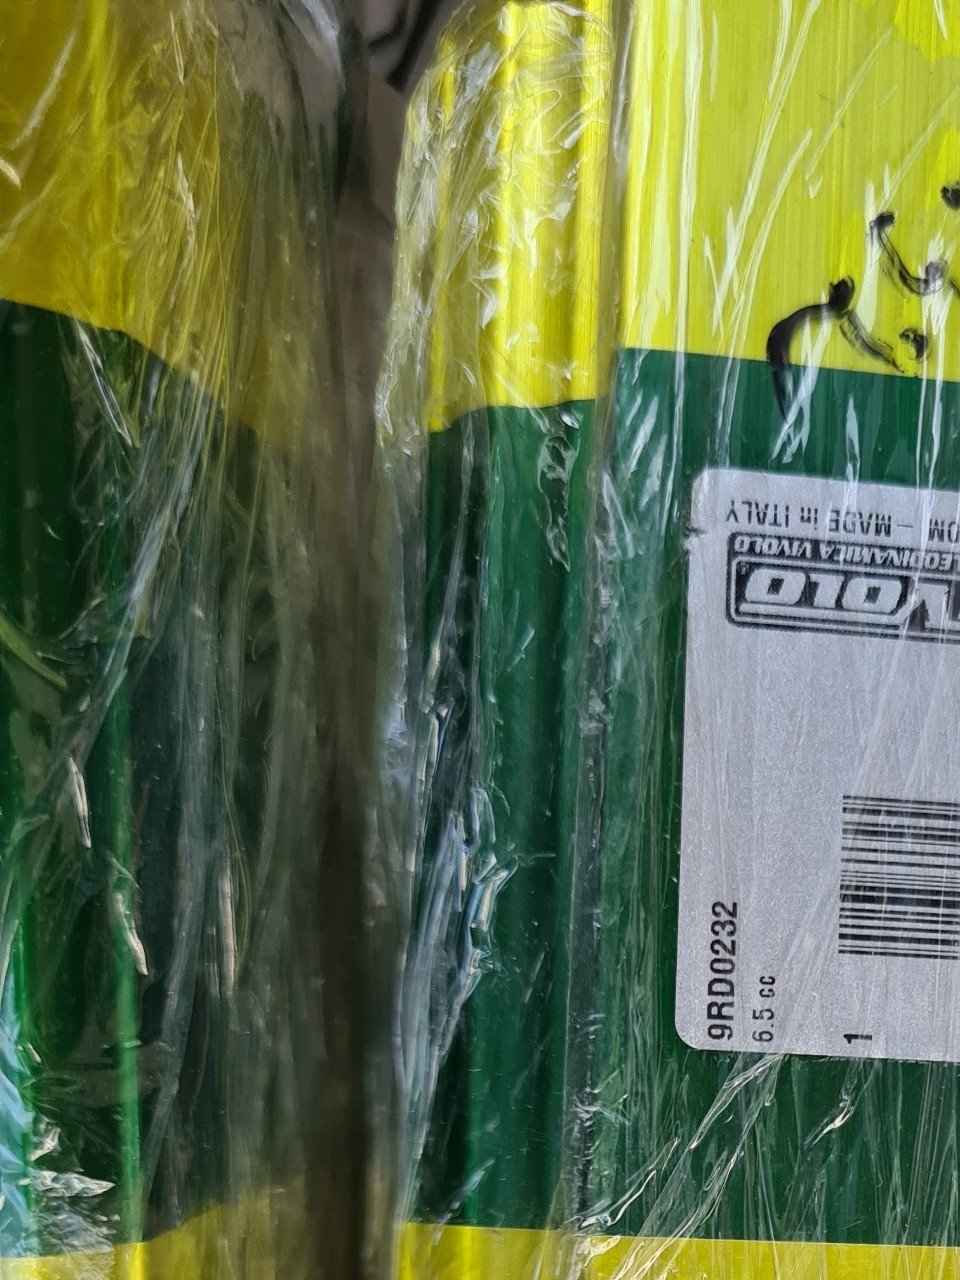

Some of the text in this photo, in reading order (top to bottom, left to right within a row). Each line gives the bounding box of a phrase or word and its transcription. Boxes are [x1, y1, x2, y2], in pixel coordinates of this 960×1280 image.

[725, 500, 790, 529] ITALY
[800, 508, 819, 530] in
[828, 509, 892, 537] MADE
[734, 534, 812, 558] VIVOLO
[706, 901, 738, 1041] 9RD0232
[752, 975, 776, 1043] 6.5 cc
[842, 1033, 872, 1045] 1
